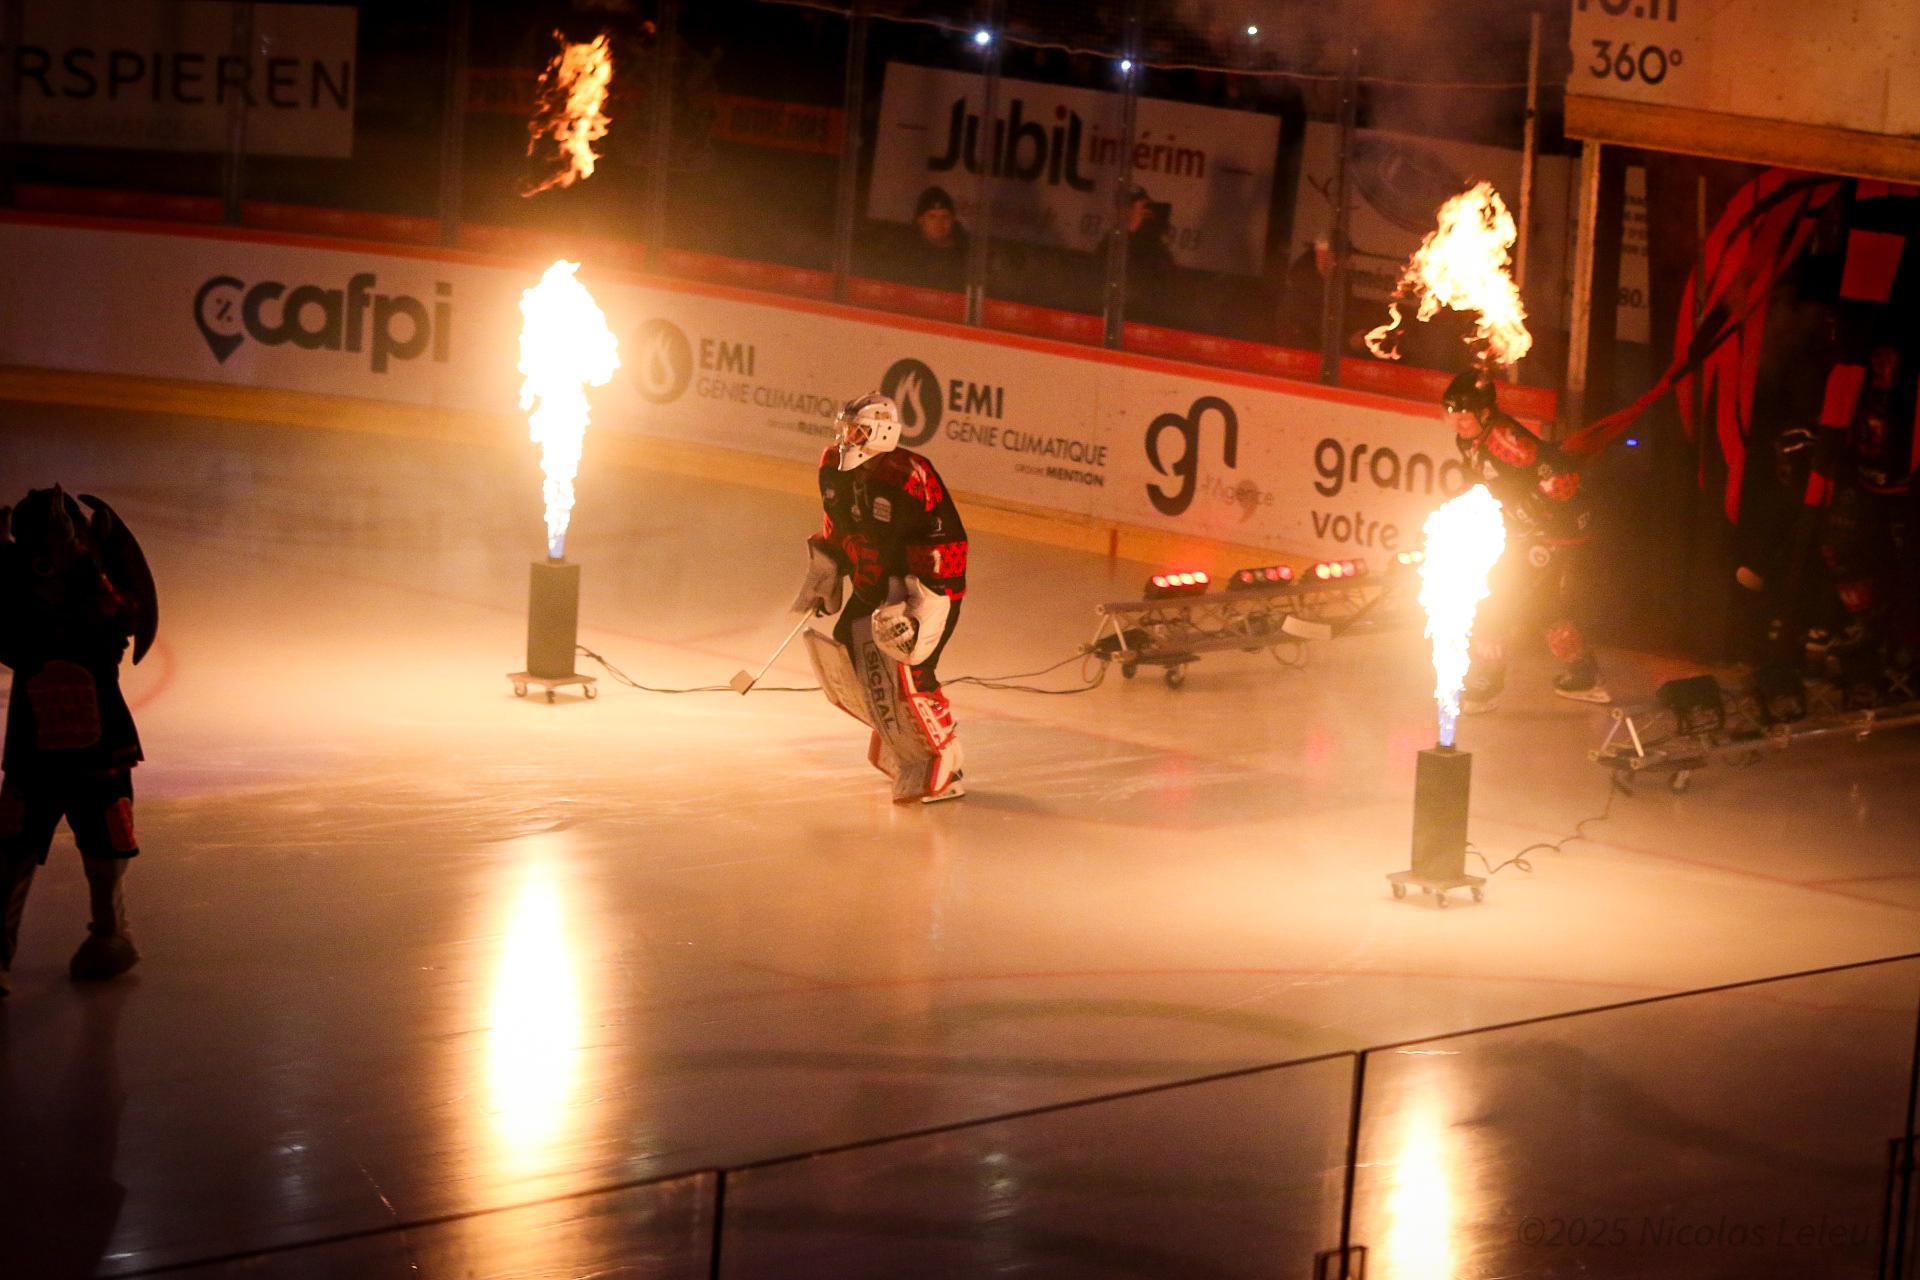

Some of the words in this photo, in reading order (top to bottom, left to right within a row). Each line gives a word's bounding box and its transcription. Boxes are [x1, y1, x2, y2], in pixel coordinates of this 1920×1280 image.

[0, 45, 350, 110] RSPIEREN
[1588, 39, 1684, 85] 360°
[926, 97, 1094, 192] Jubil
[700, 338, 756, 377] EMI
[948, 379, 1005, 419] EMI
[945, 416, 998, 448] GÉNIE
[1001, 429, 1109, 467] CLIMATIQUE
[1311, 510, 1400, 551] votre
